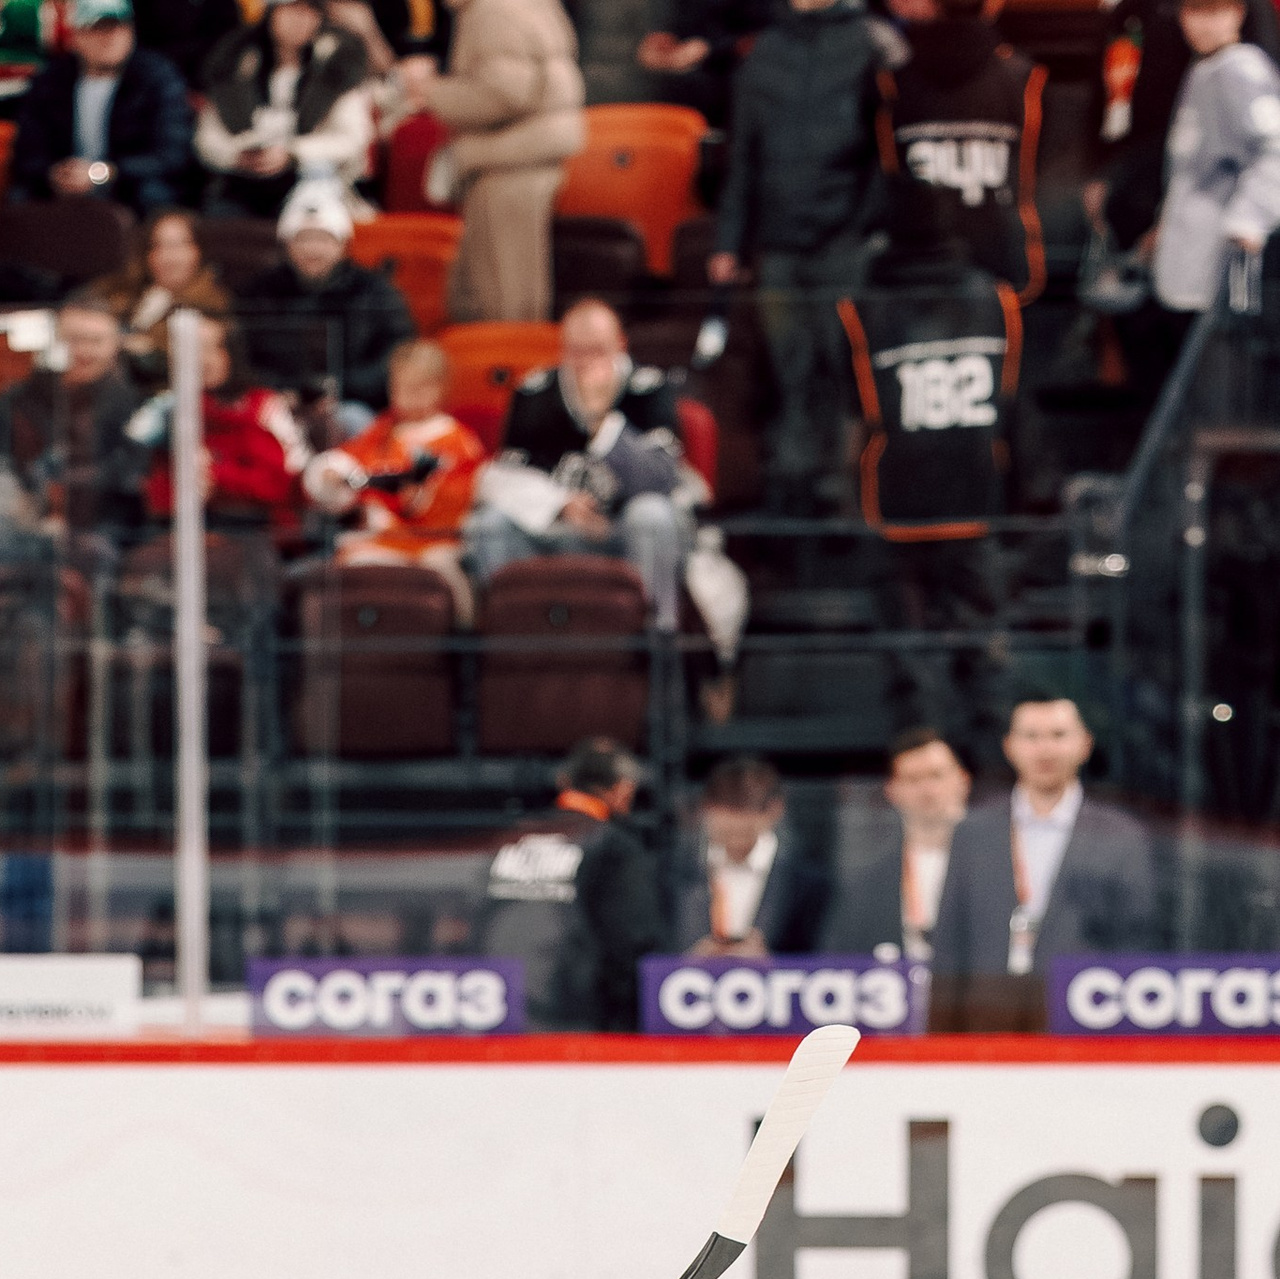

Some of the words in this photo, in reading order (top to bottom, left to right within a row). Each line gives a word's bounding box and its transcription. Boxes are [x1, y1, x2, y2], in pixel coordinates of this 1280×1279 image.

[896, 354, 997, 432] 182
[262, 967, 508, 1031] согаз
[658, 966, 908, 1031] согаз
[1066, 966, 1280, 1030] сога
